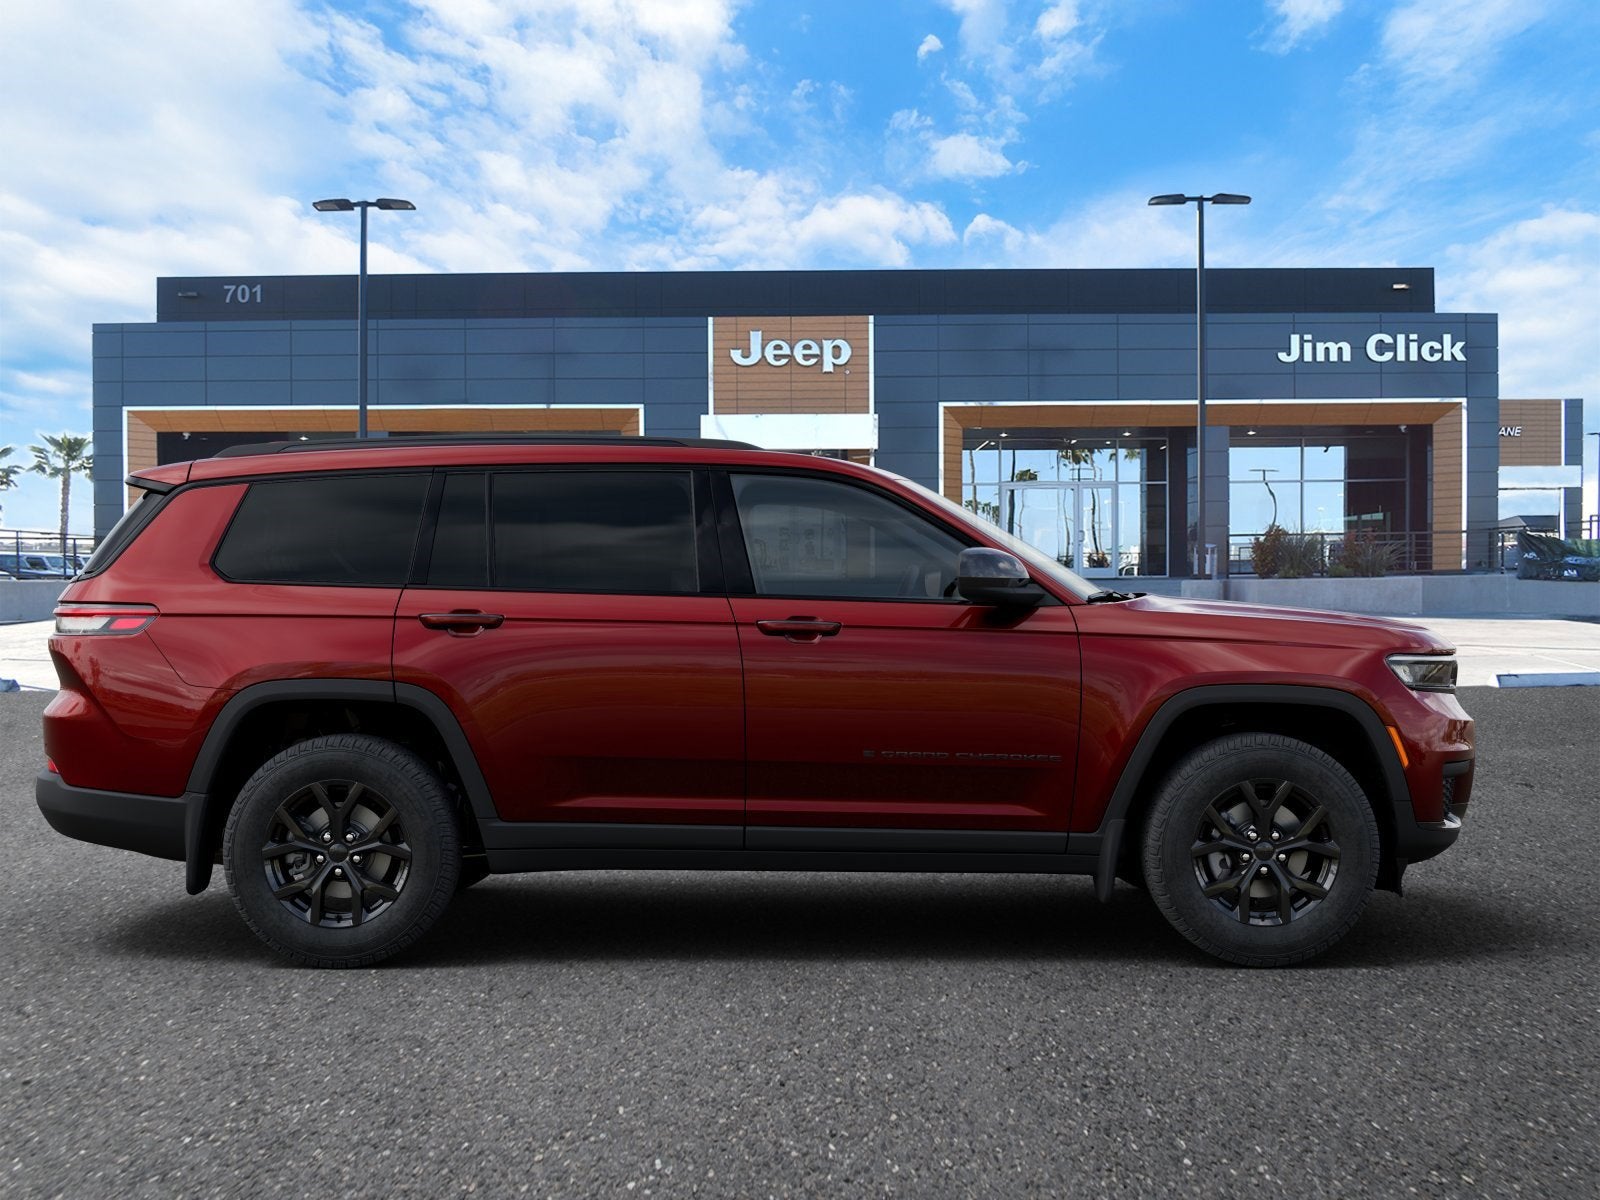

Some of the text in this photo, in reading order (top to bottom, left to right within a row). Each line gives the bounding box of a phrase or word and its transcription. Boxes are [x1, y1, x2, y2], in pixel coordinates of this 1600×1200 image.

[223, 284, 263, 304] 701
[729, 330, 852, 373] Jeep
[1277, 333, 1467, 363] Jim Click
[880, 750, 1063, 763] GRAND CHEROKEE
